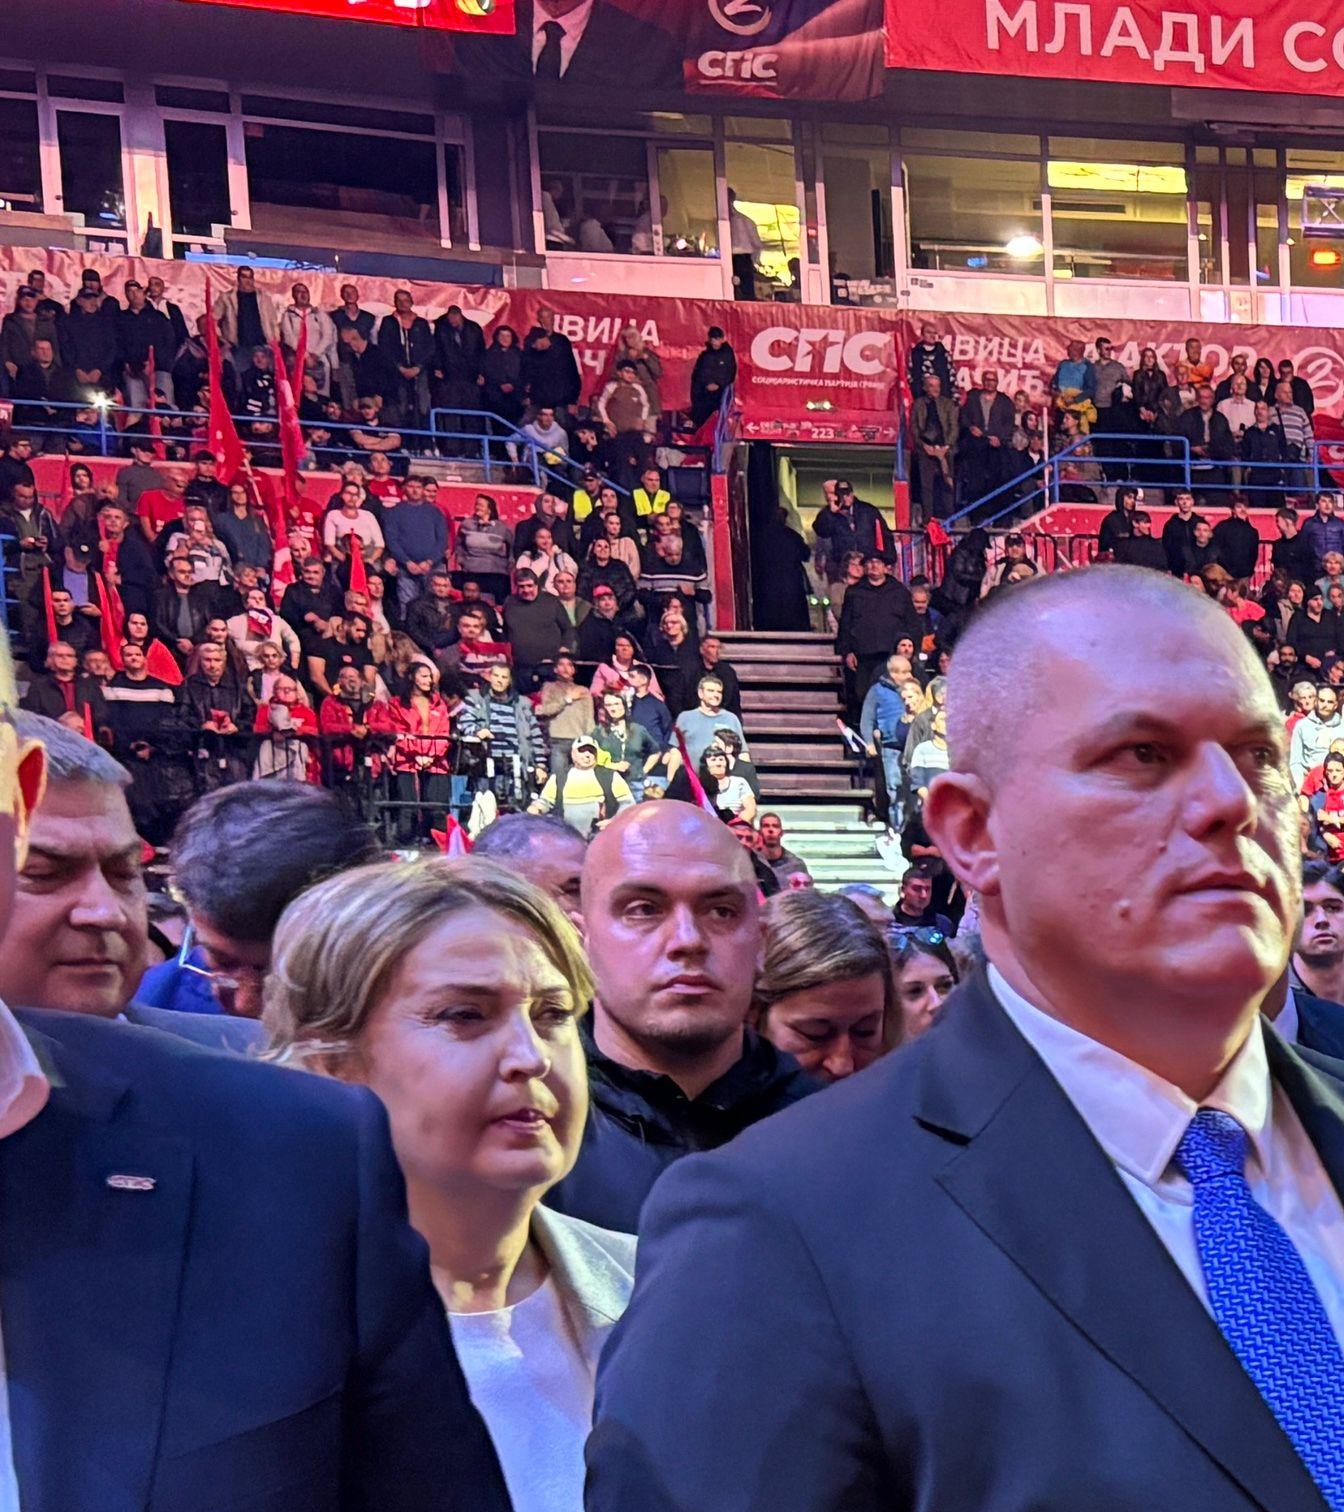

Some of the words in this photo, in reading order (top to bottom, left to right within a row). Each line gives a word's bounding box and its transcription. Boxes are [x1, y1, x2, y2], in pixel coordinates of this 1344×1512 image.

[984, 0, 1256, 74] МЛАДИ
[751, 327, 893, 376] СПС
[811, 428, 834, 439] 223
